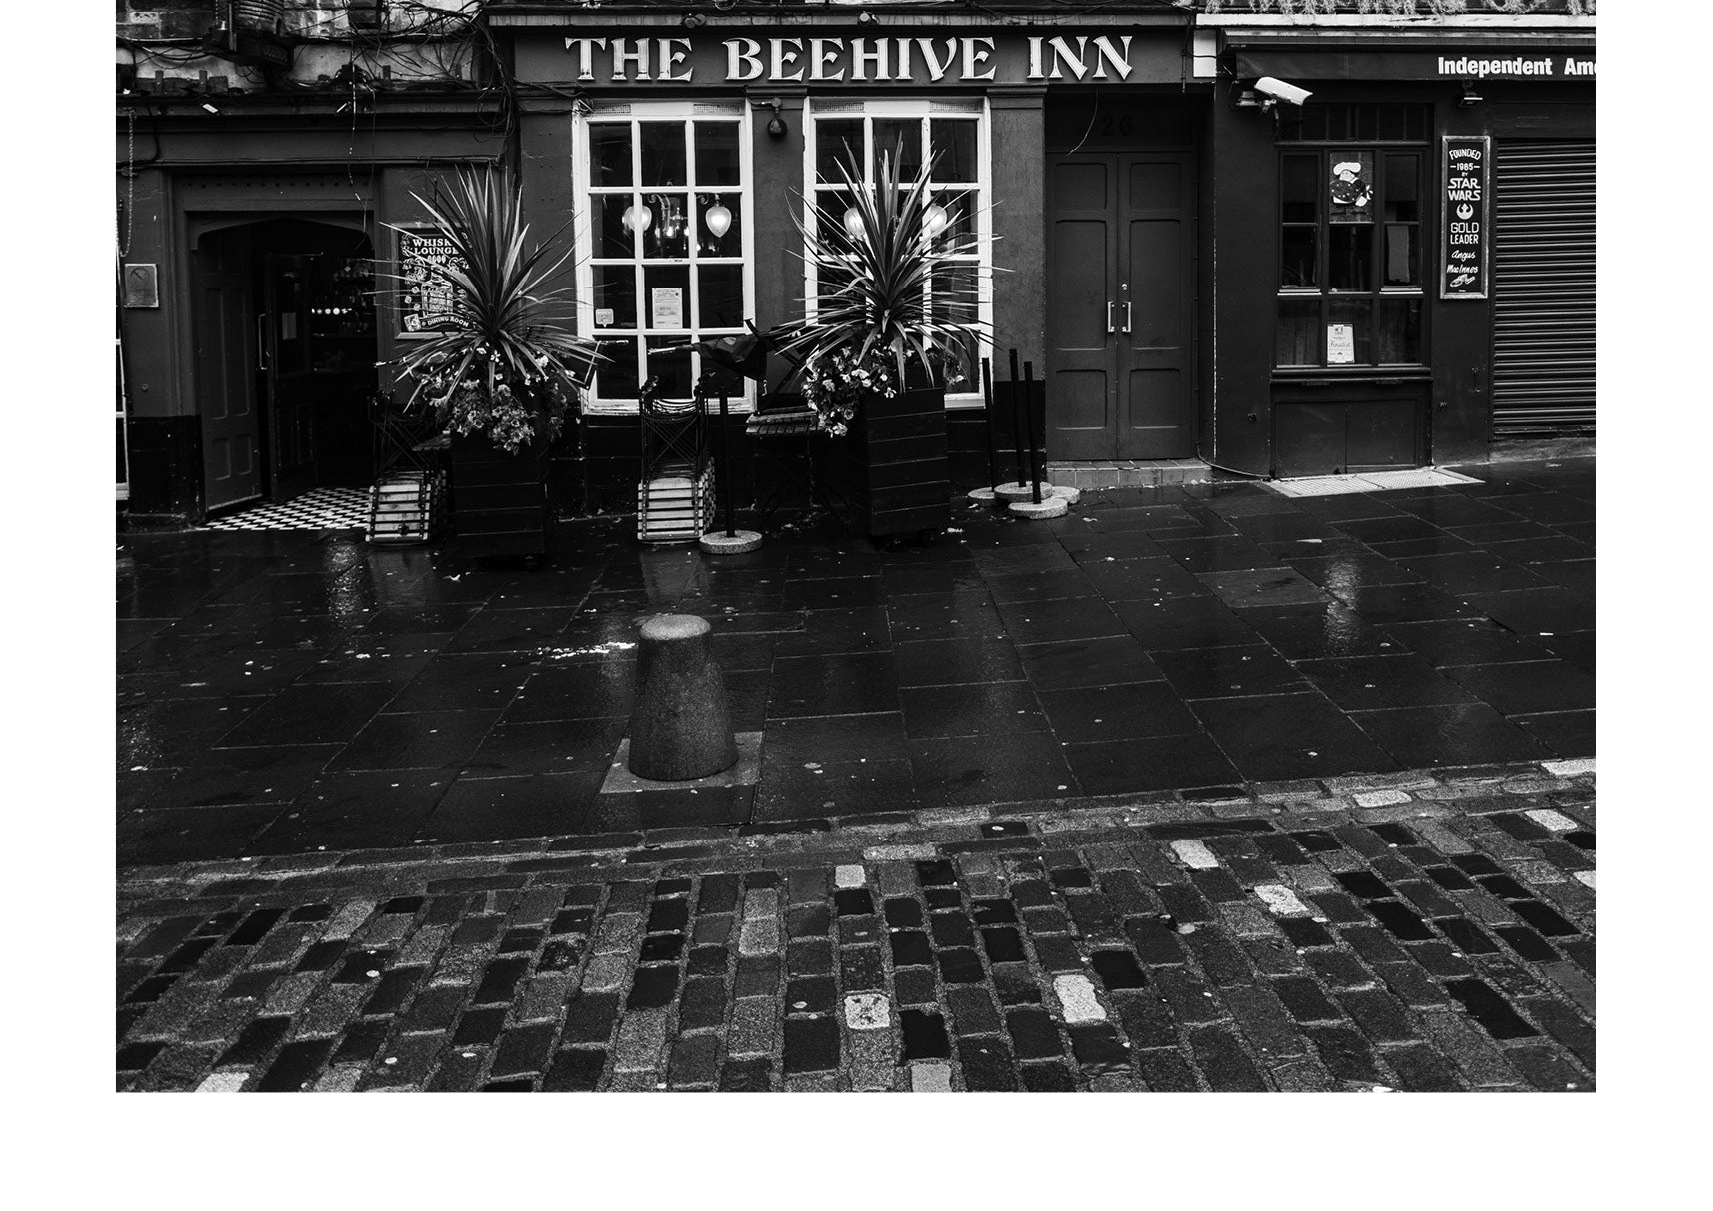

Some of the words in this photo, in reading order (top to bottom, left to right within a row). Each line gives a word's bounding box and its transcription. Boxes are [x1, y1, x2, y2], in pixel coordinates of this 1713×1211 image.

[564, 37, 694, 81] THE
[722, 36, 997, 82] BEEHIVE
[1026, 35, 1134, 82] INN
[1438, 56, 1553, 78] Independent
[1448, 148, 1482, 161] FOUNDED
[1447, 177, 1481, 189] STAR
[1447, 189, 1481, 202] WARS
[1450, 222, 1480, 234] GOLD
[412, 238, 454, 247] WHISK
[1449, 234, 1479, 245] LEADER
[414, 246, 460, 255] LOUNGE
[1451, 249, 1476, 263] Angus
[450, 316, 470, 327] ROOM
